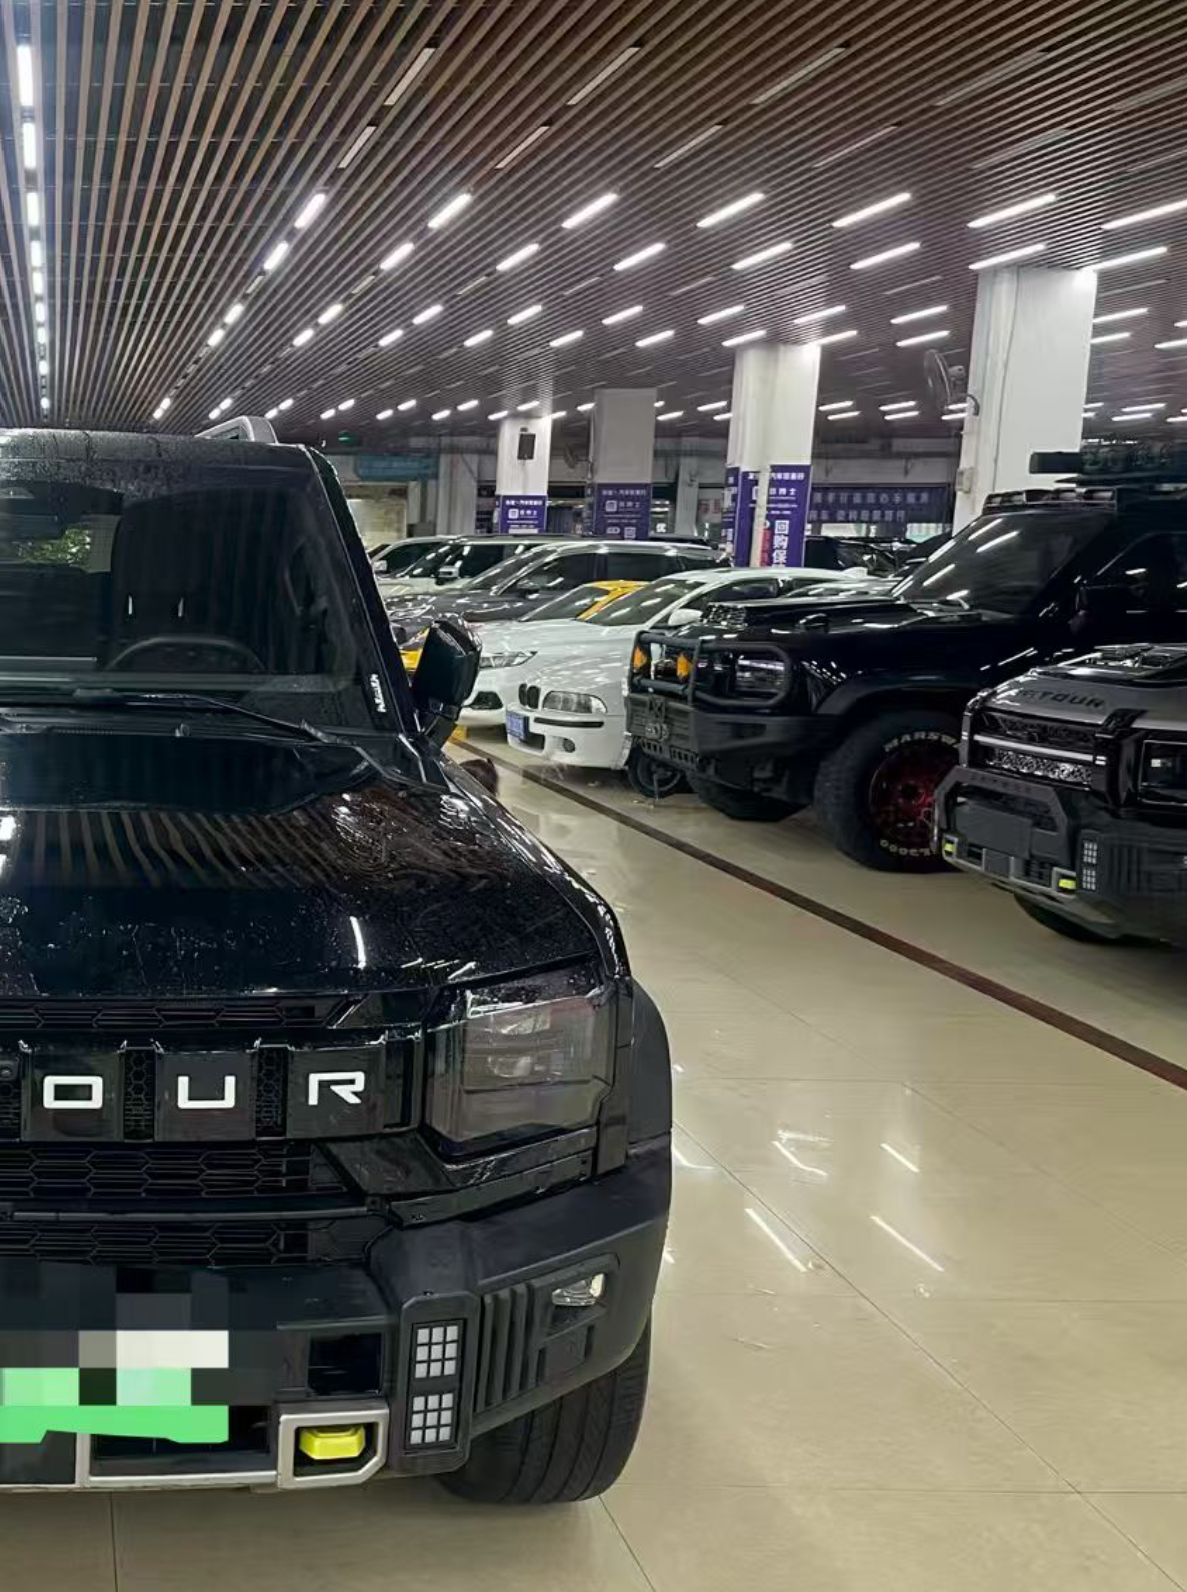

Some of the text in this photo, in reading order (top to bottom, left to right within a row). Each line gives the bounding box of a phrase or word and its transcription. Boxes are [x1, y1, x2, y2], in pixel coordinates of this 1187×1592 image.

[772, 520, 789, 567] 回购保
[1016, 688, 1105, 709] TOUR
